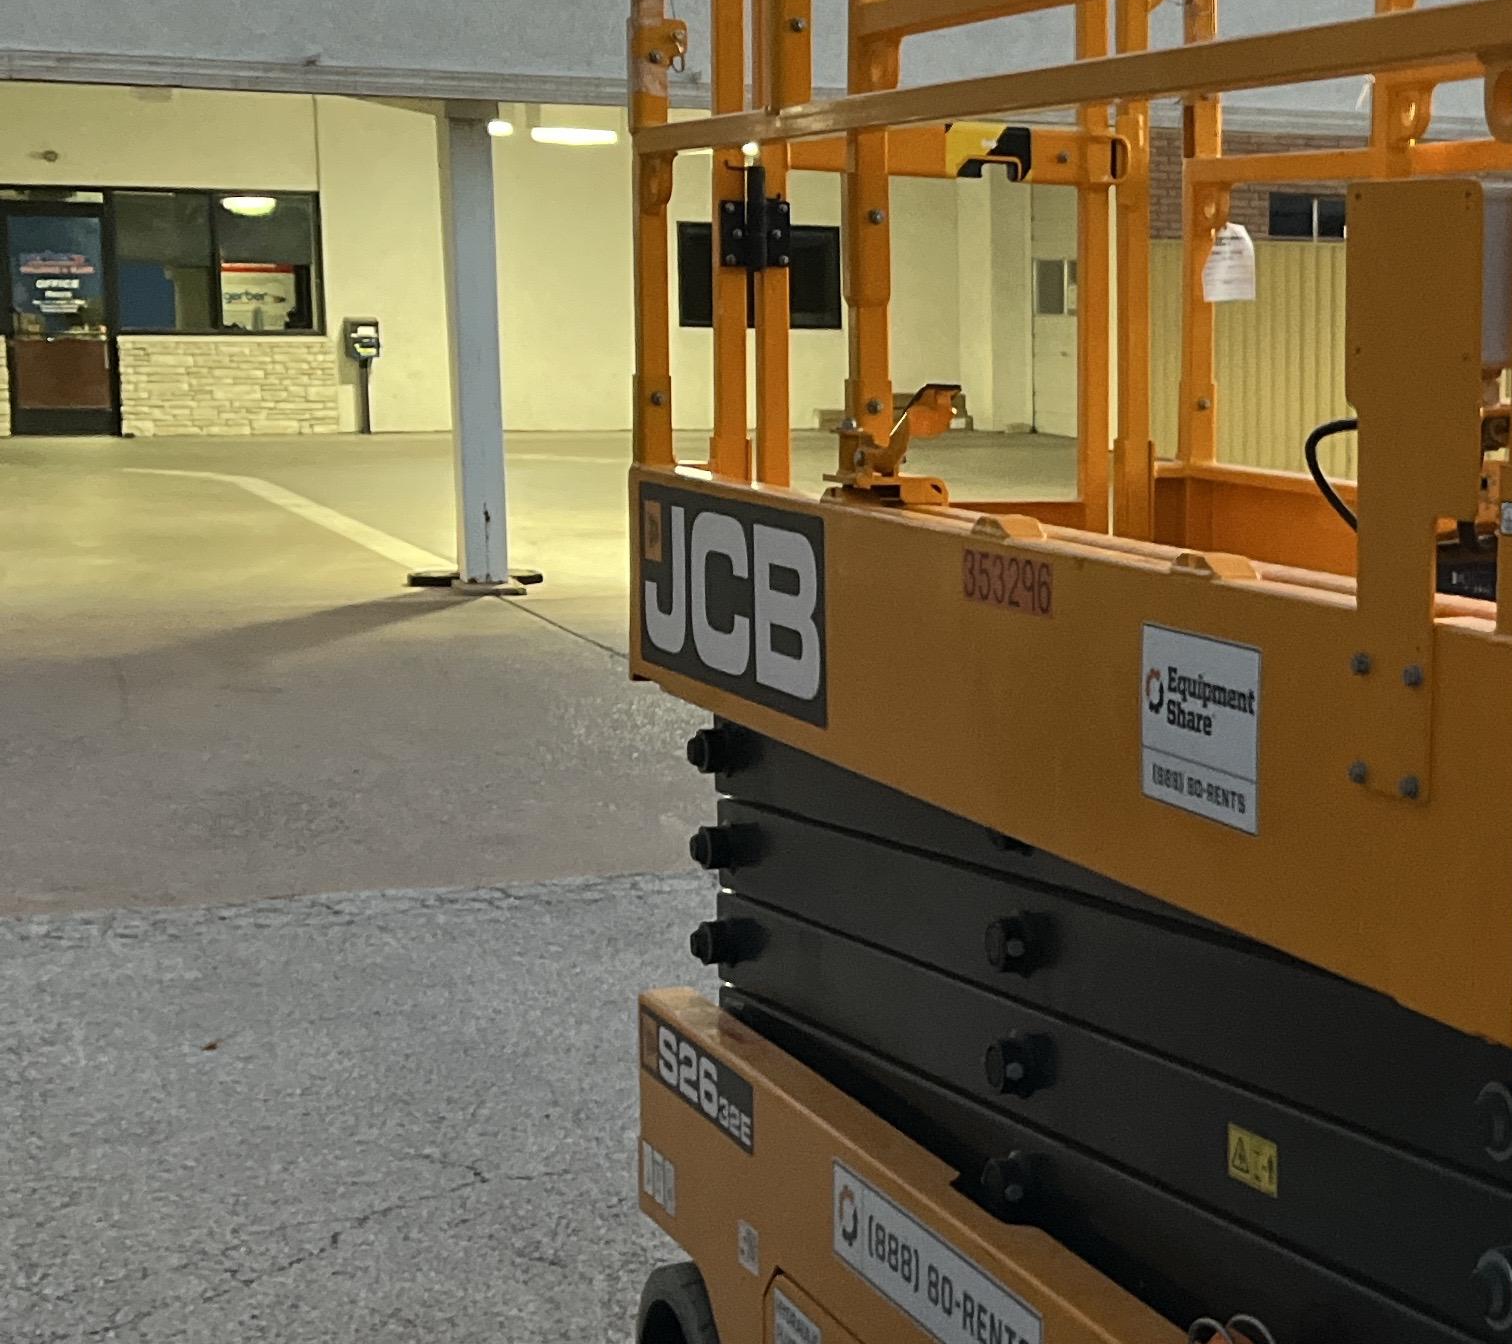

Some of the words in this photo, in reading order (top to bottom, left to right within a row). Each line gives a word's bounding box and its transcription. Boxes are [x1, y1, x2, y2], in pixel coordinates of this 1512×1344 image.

[644, 505, 820, 701] JCB
[963, 548, 1052, 614] 353296
[1166, 698, 1213, 736] Share
[1167, 666, 1255, 715] Equipment
[1186, 774, 1246, 814] 80-RENTS
[867, 1214, 920, 1293] (888)
